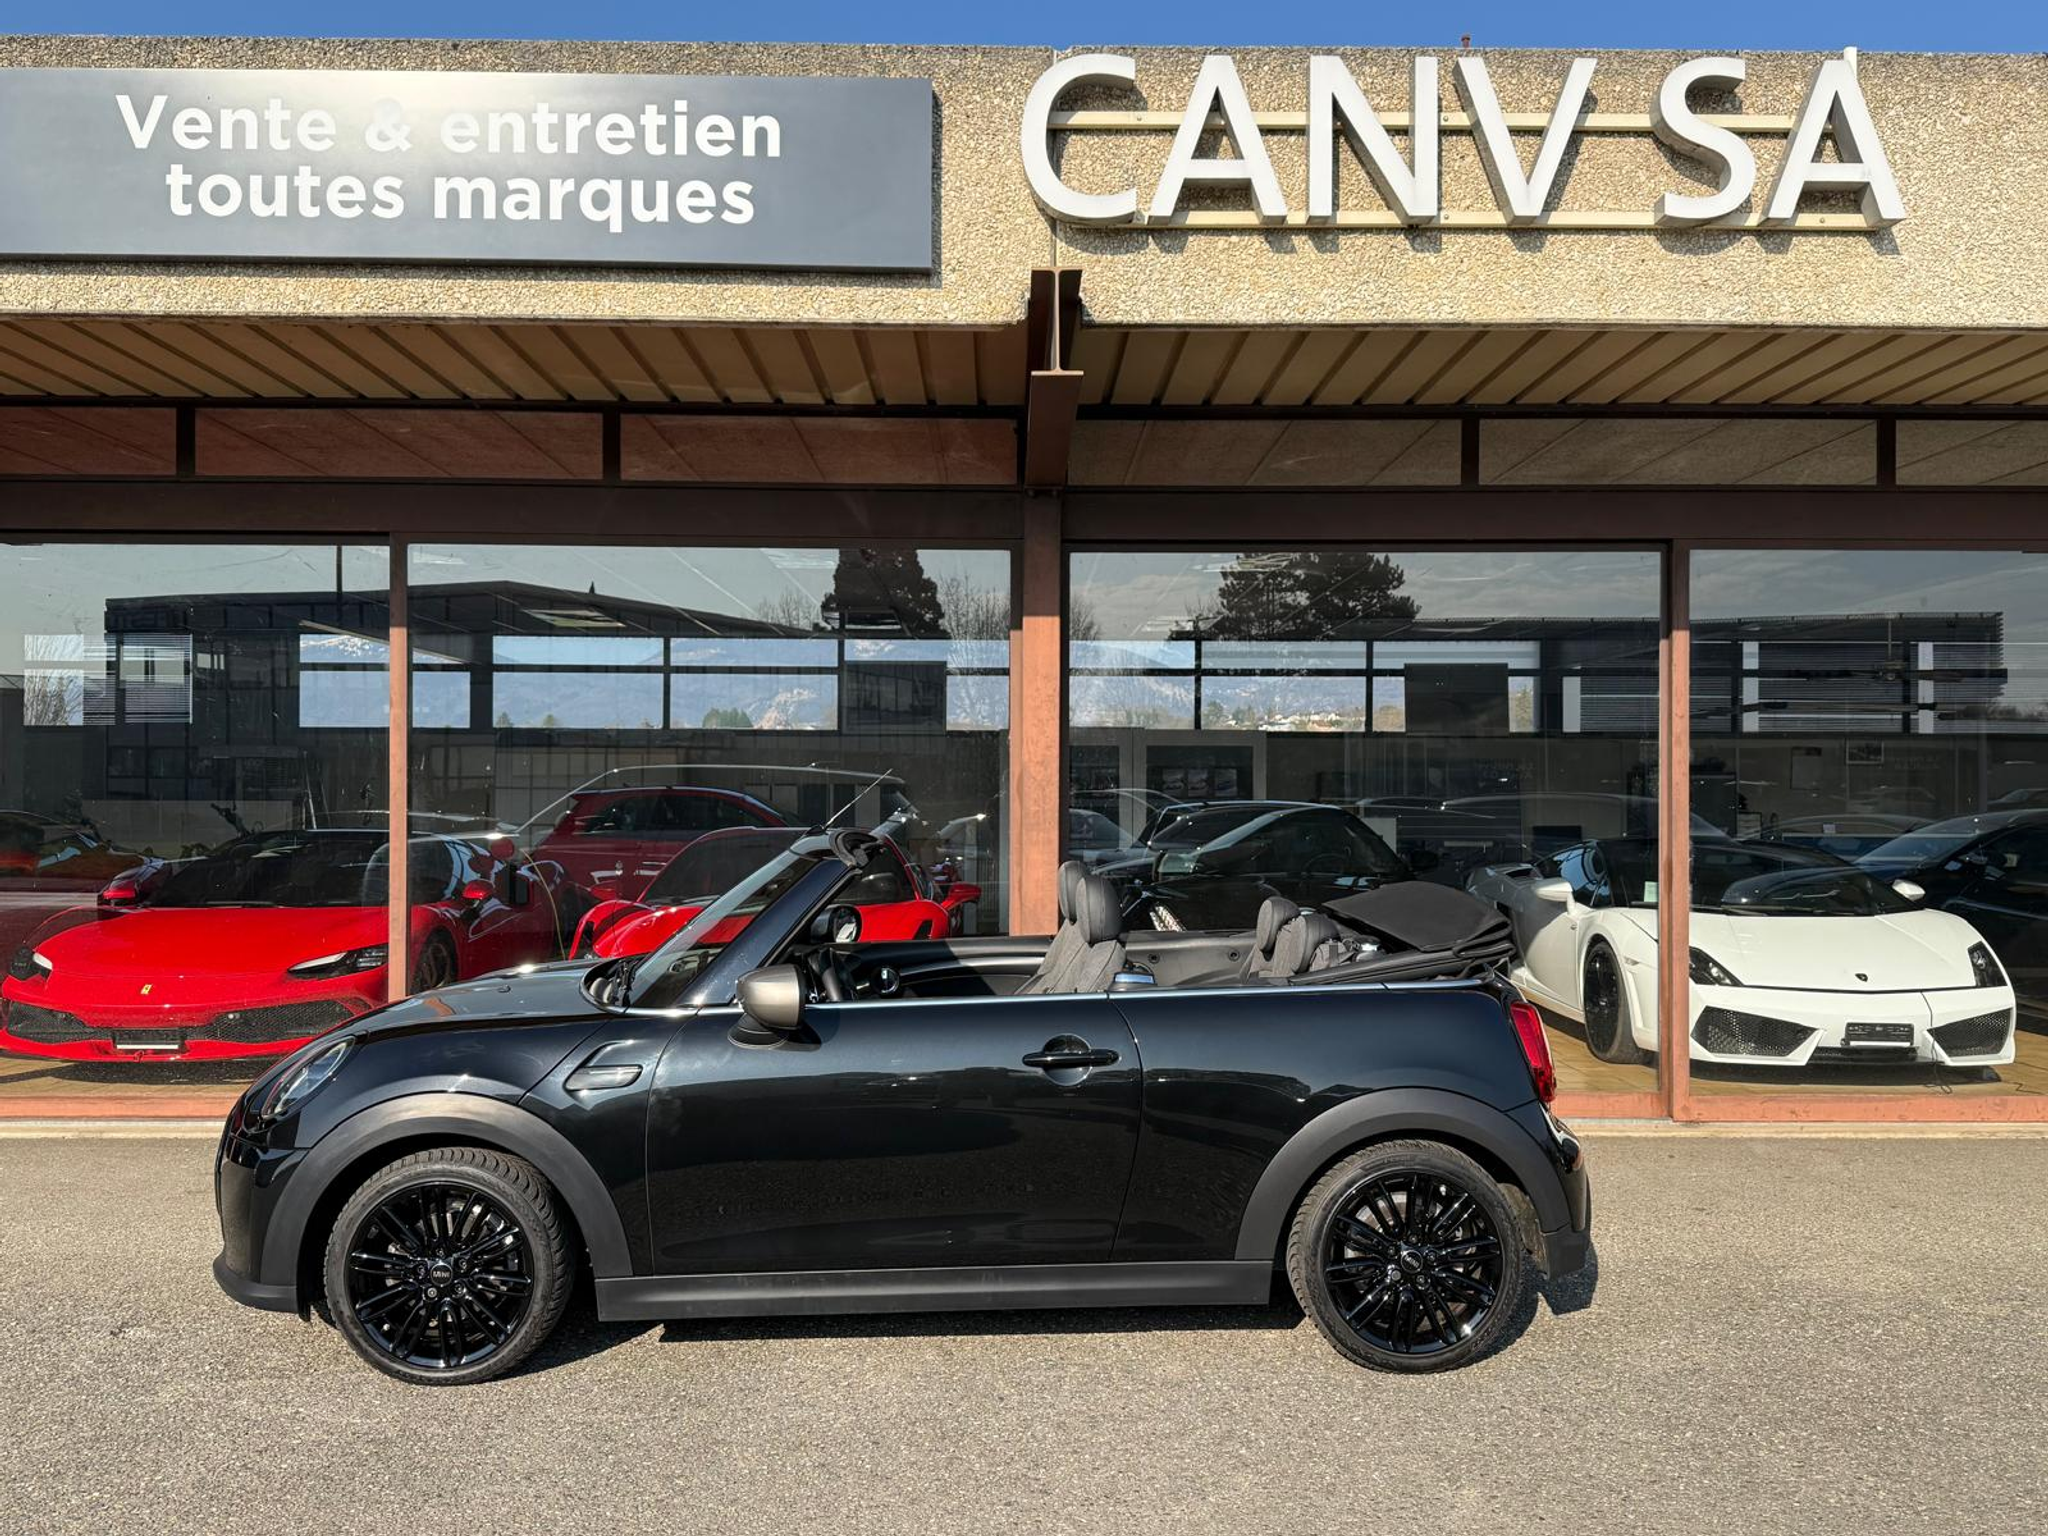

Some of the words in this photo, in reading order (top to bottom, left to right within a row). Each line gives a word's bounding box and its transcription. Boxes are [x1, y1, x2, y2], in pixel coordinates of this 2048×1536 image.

[114, 94, 337, 151] Vente
[365, 98, 412, 152] &
[438, 99, 782, 158] entretien
[1020, 54, 1597, 227] CANV
[1653, 55, 1907, 230] SA
[165, 163, 405, 218] toutes
[433, 174, 755, 234] marques
